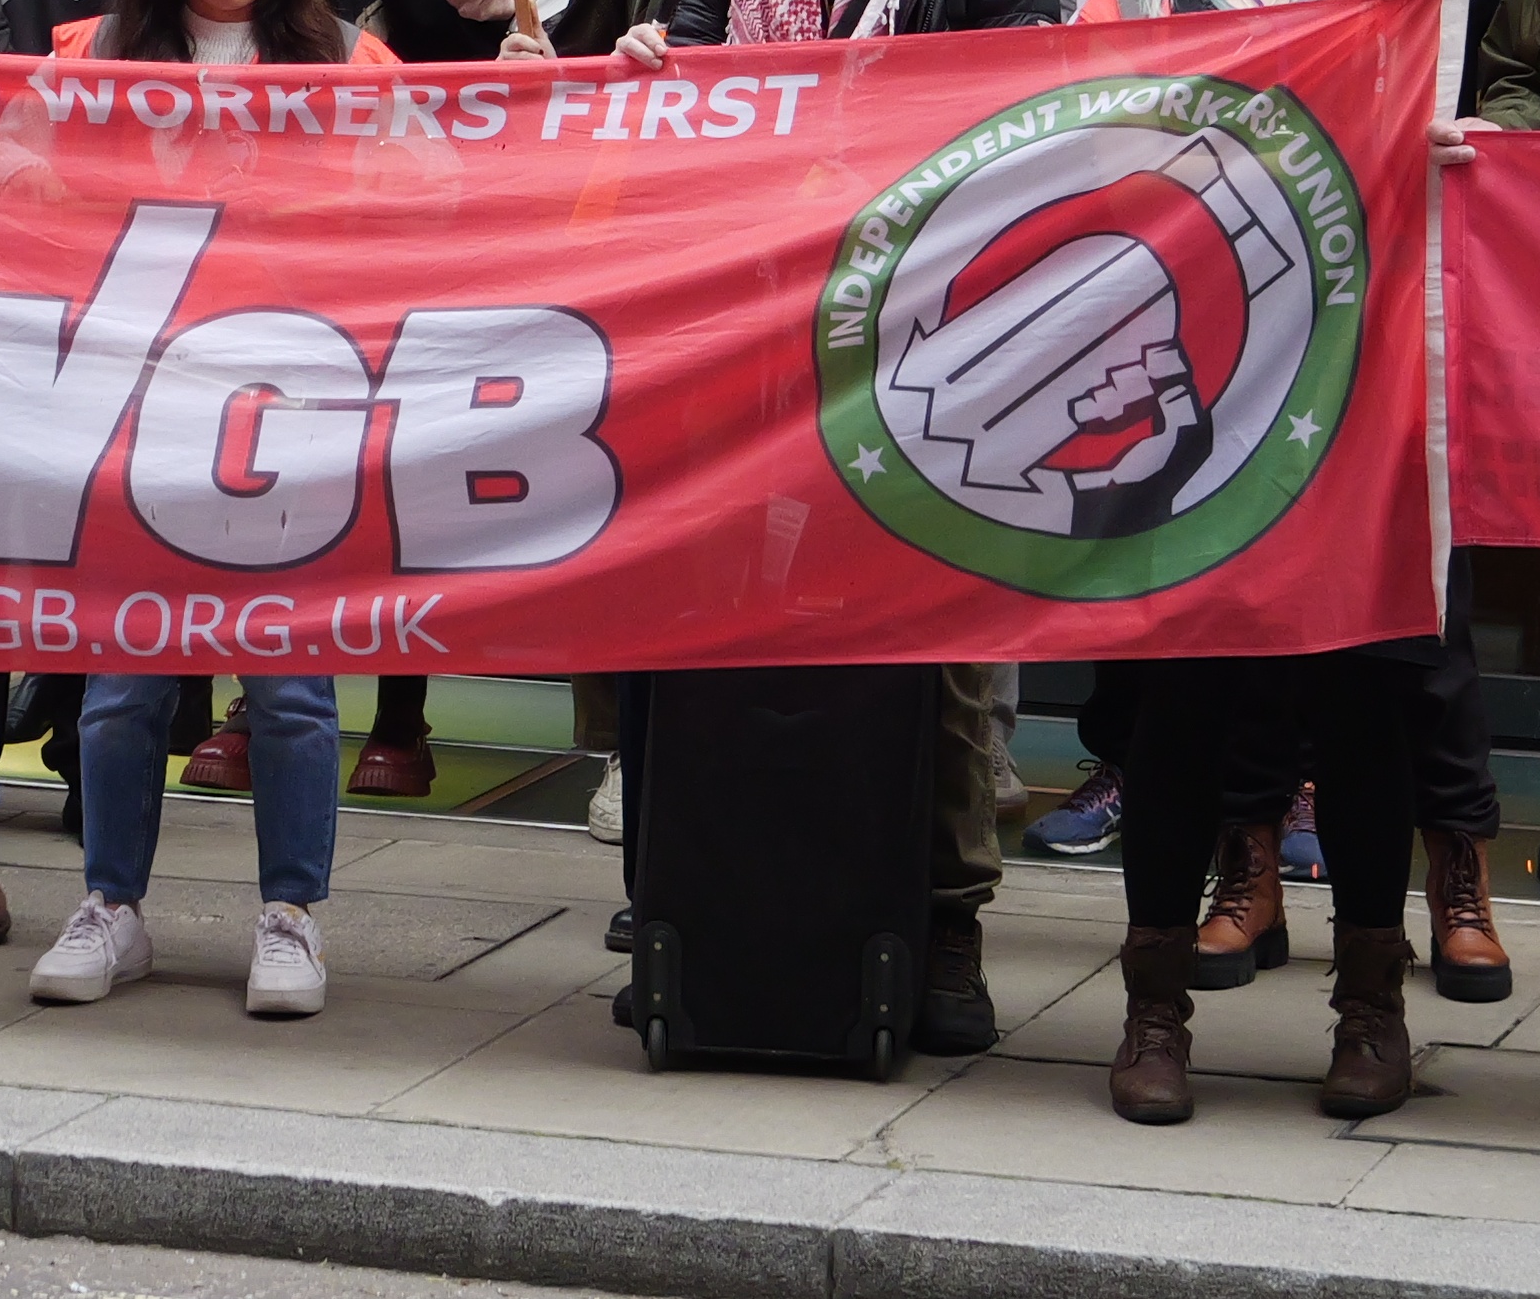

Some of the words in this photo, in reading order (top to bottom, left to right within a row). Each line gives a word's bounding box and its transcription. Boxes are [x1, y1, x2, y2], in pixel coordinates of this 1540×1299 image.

[27, 76, 511, 142] WORKERS
[540, 72, 820, 141] FIRST
[827, 100, 1060, 351] INDEPENDENT
[1278, 131, 1356, 307] UNION
